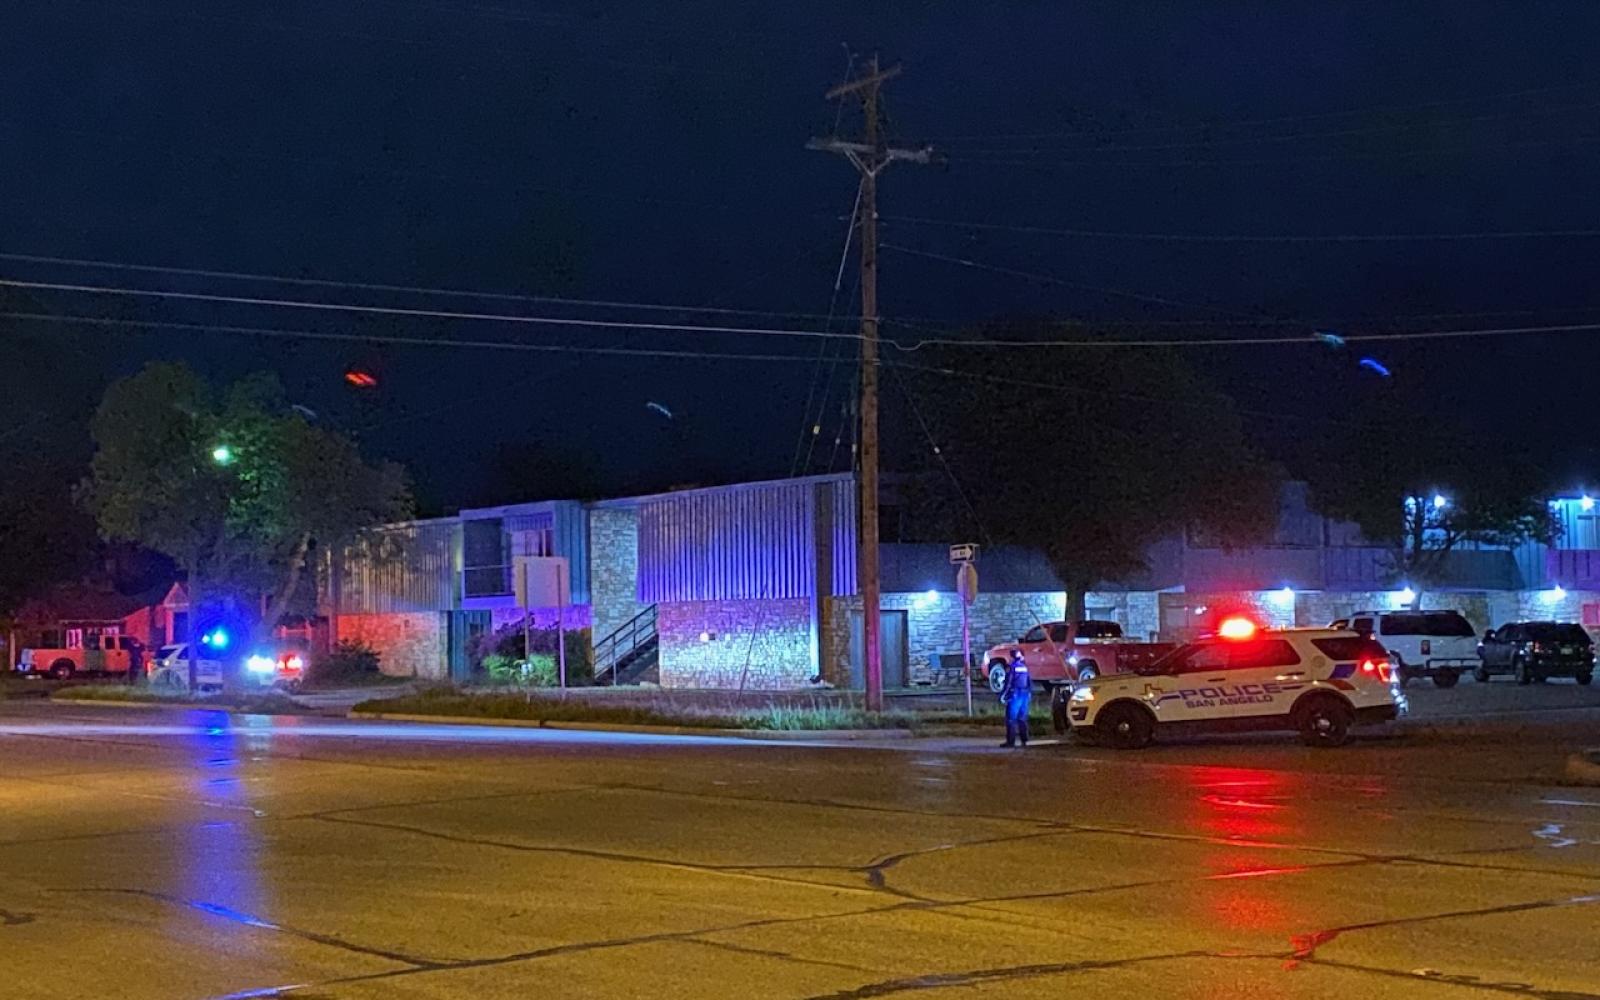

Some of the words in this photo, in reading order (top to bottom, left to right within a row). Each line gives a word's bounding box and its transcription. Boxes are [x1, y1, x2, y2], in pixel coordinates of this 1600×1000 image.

[1179, 683, 1283, 700] POLICE
[1186, 699, 1216, 709] SAN
[1219, 694, 1273, 706] ANGELO
